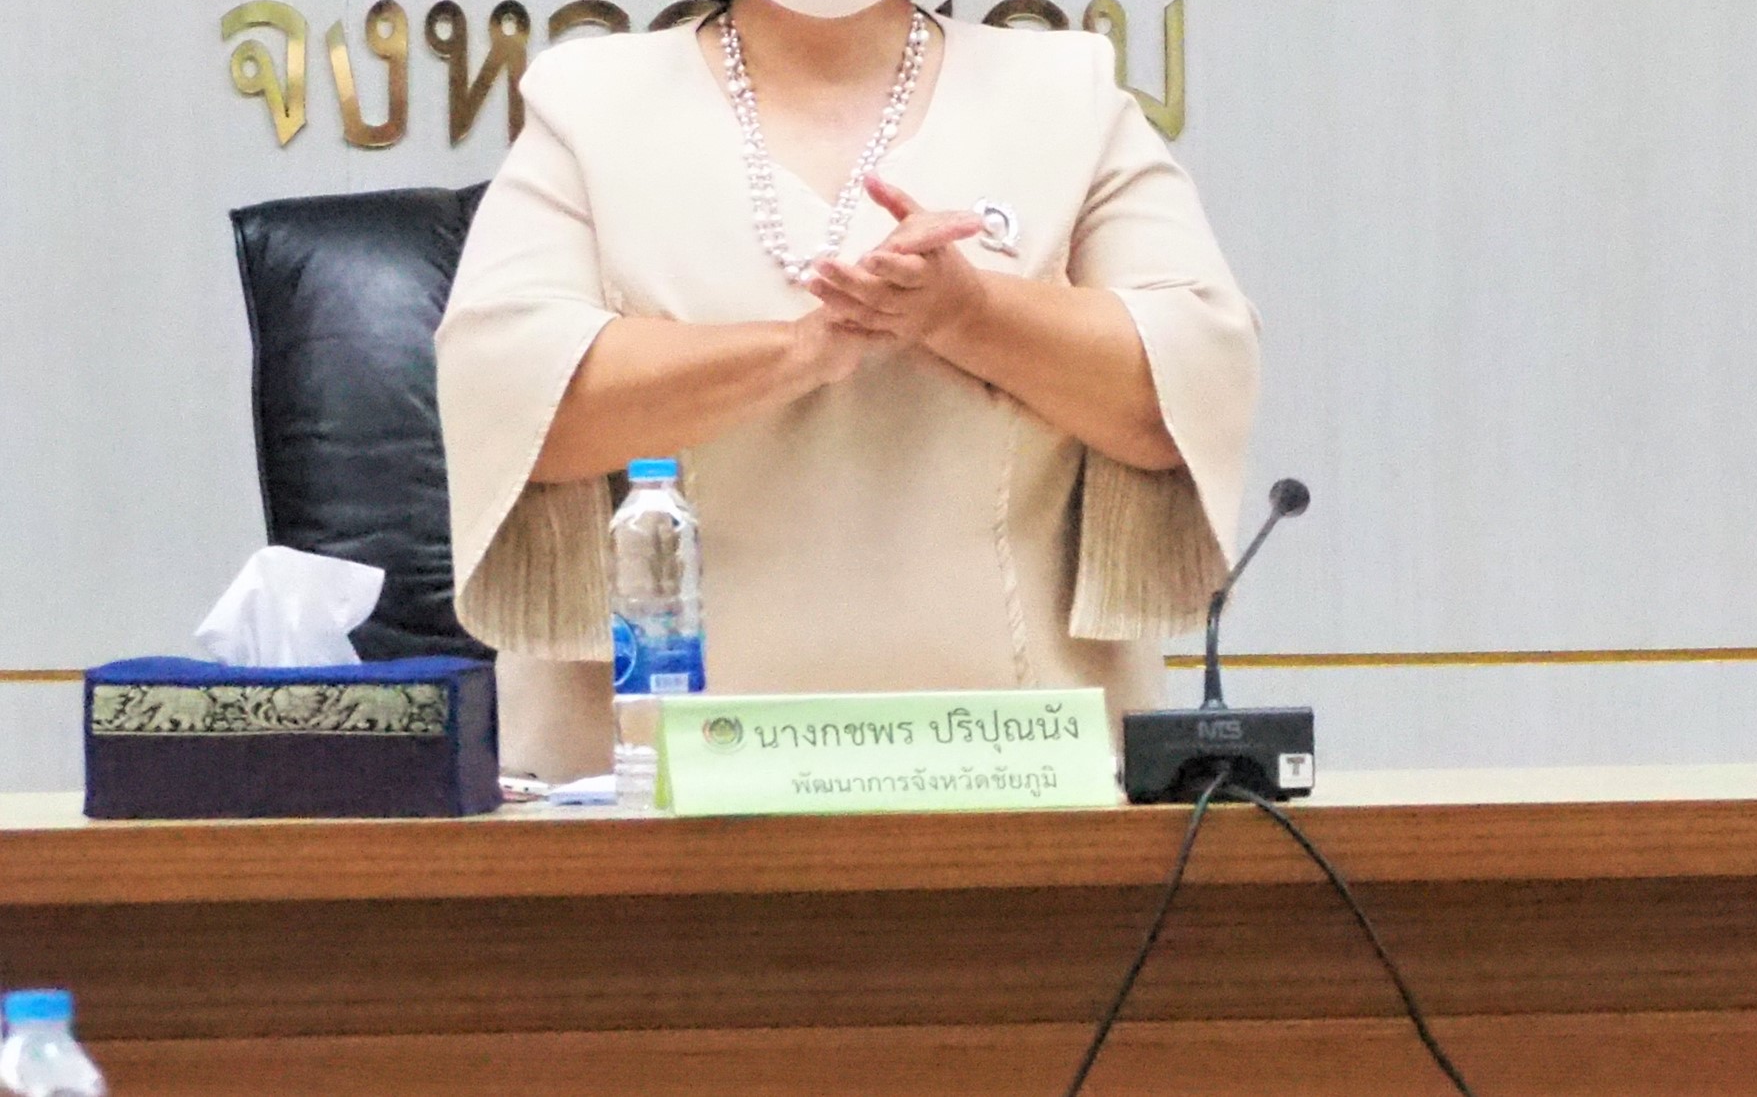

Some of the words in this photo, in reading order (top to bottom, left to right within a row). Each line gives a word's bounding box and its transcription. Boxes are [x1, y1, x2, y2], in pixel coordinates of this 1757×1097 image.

[754, 714, 914, 749] นางกชพร
[791, 765, 1058, 798] พัฒนาการจังหวัดชัยภูมิ
